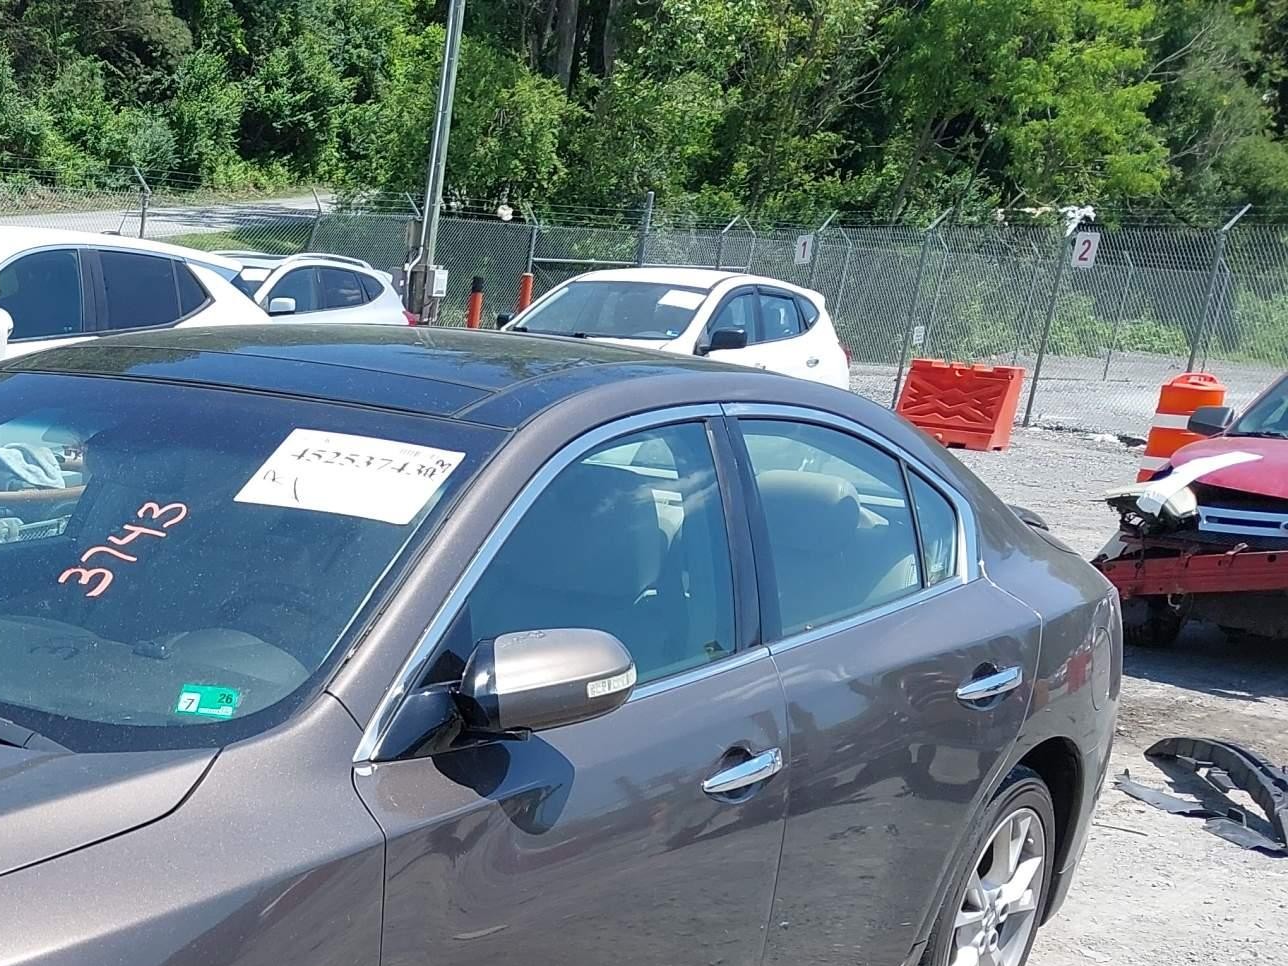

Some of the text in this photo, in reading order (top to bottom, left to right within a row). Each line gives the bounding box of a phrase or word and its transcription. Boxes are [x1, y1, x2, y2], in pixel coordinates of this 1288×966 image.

[800, 240, 808, 259] 1
[1077, 239, 1092, 261] 2
[58, 502, 187, 597] 3743
[184, 698, 195, 711] 7
[217, 693, 233, 704] 26
